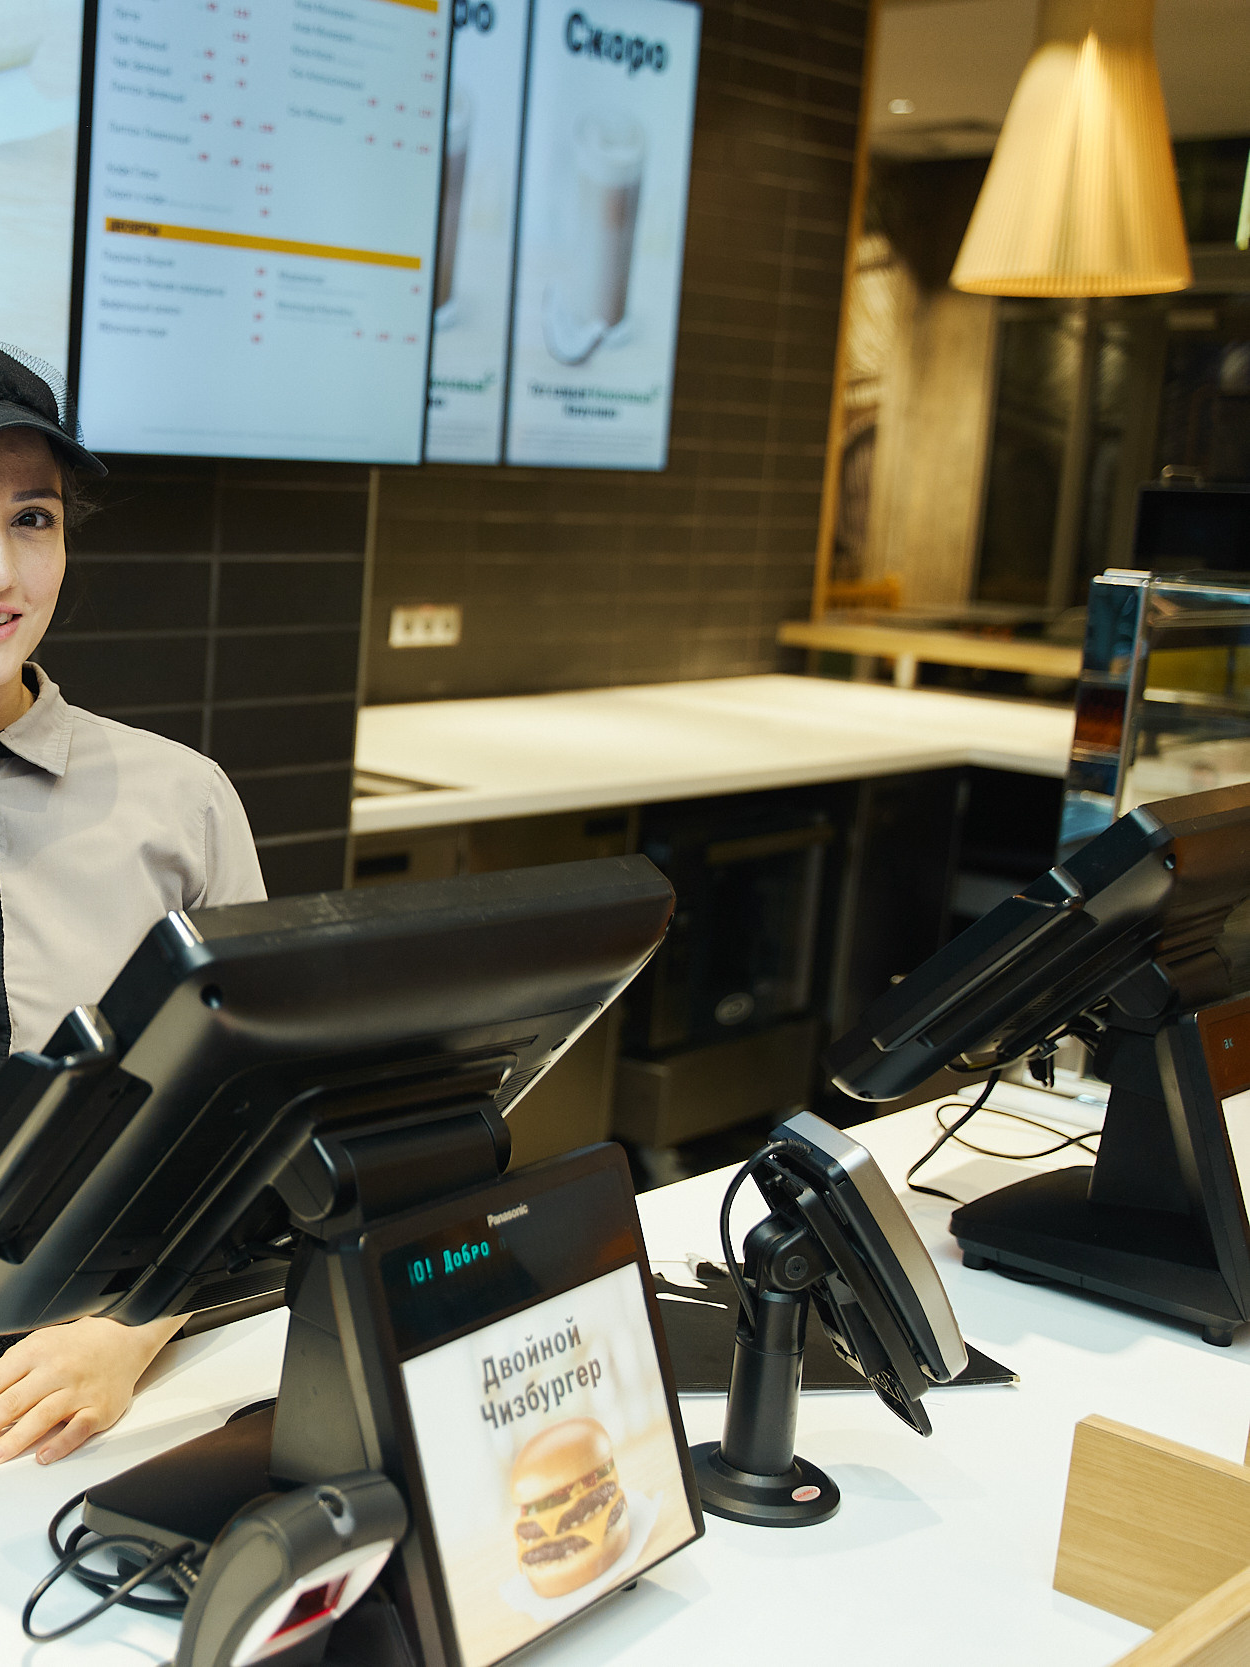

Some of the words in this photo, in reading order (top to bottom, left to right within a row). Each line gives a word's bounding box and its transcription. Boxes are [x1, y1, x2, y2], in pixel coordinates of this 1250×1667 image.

[565, 11, 667, 76] Скоро
[487, 1203, 529, 1228] Panasonic
[443, 1241, 490, 1275] Добро
[481, 1316, 582, 1394] Двойной
[480, 1358, 602, 1430] Чизбургер
